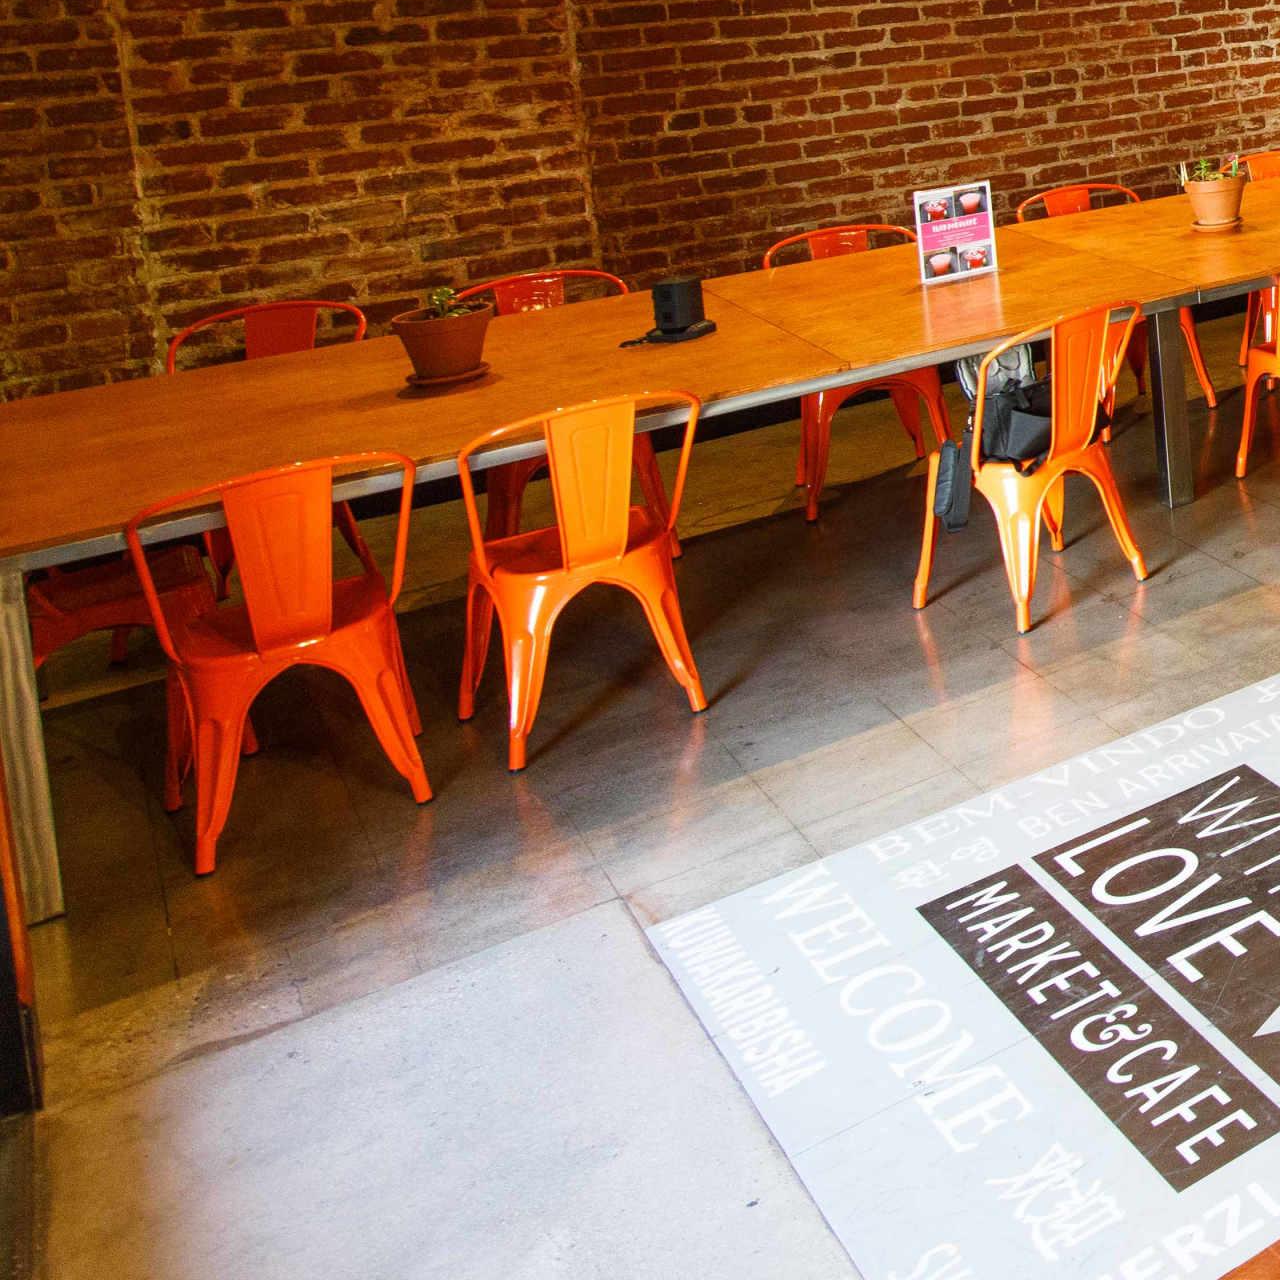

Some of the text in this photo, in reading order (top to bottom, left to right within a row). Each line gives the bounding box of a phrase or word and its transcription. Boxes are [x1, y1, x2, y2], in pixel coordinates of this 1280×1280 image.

[866, 707, 1226, 864] BEM-VINDO
[1018, 791, 1101, 839] BEN
[762, 856, 1035, 1153] WELCOME
